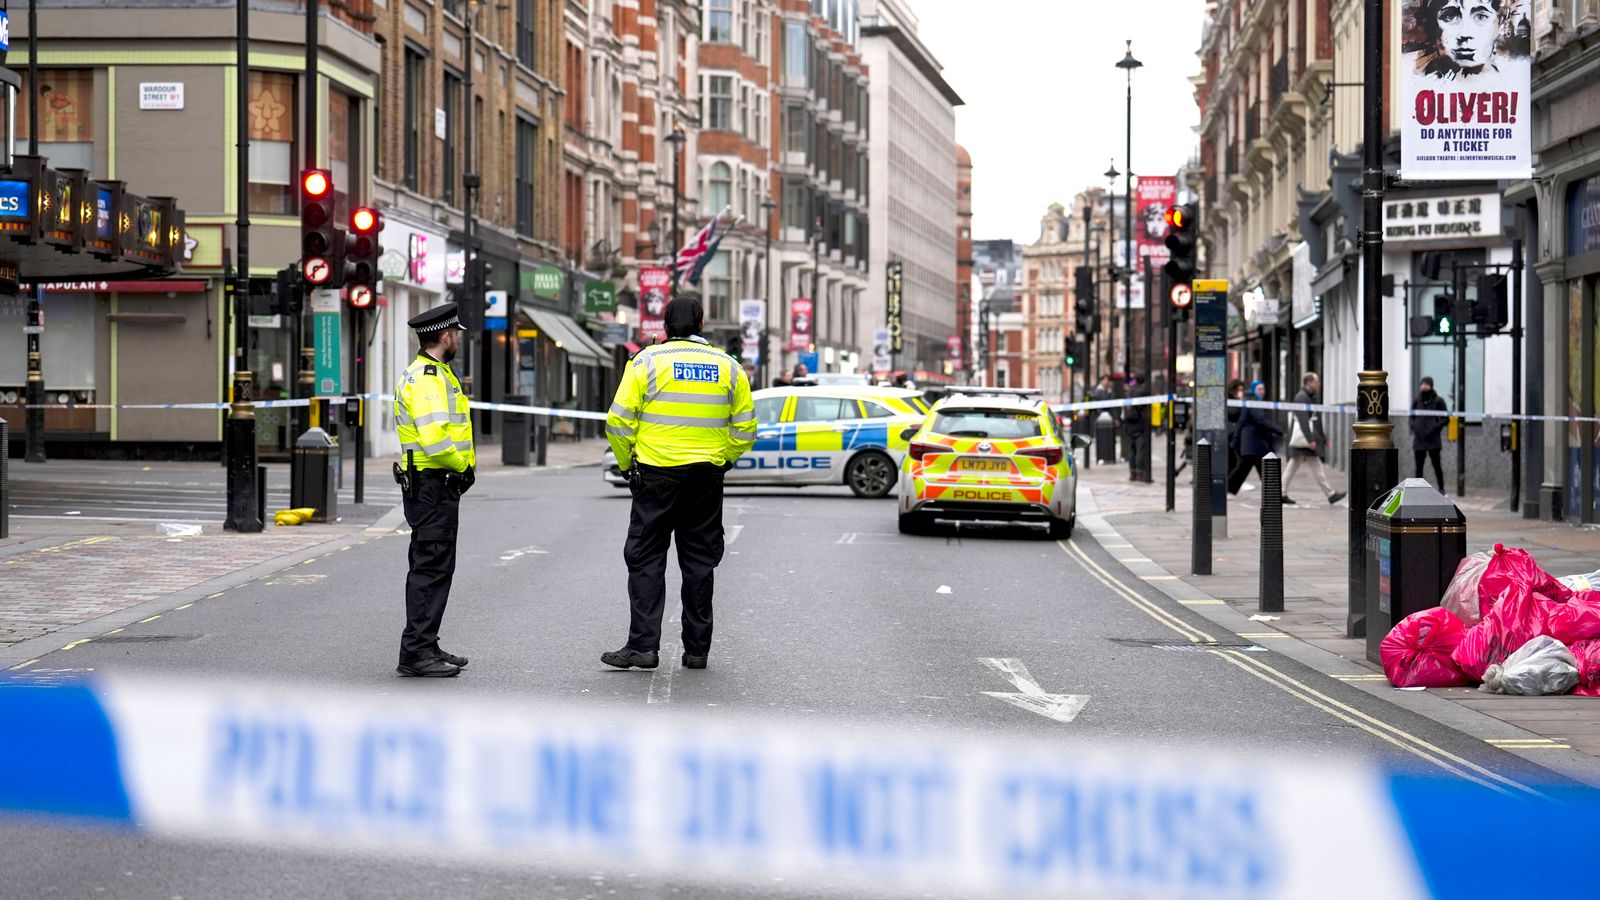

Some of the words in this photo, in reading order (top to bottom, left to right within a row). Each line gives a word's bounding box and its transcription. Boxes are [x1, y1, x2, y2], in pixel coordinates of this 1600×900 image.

[1414, 89, 1519, 126] OLIVER!
[1420, 128, 1435, 139] DO
[1437, 128, 1490, 139] ANYTHING
[1492, 128, 1512, 139] FOR
[1443, 141, 1451, 152] A
[1453, 141, 1489, 152] TICKET
[1418, 223, 1432, 235] FU
[675, 368, 718, 381] POLICE
[733, 456, 832, 470] OLICE
[953, 490, 1012, 501] POLICE
